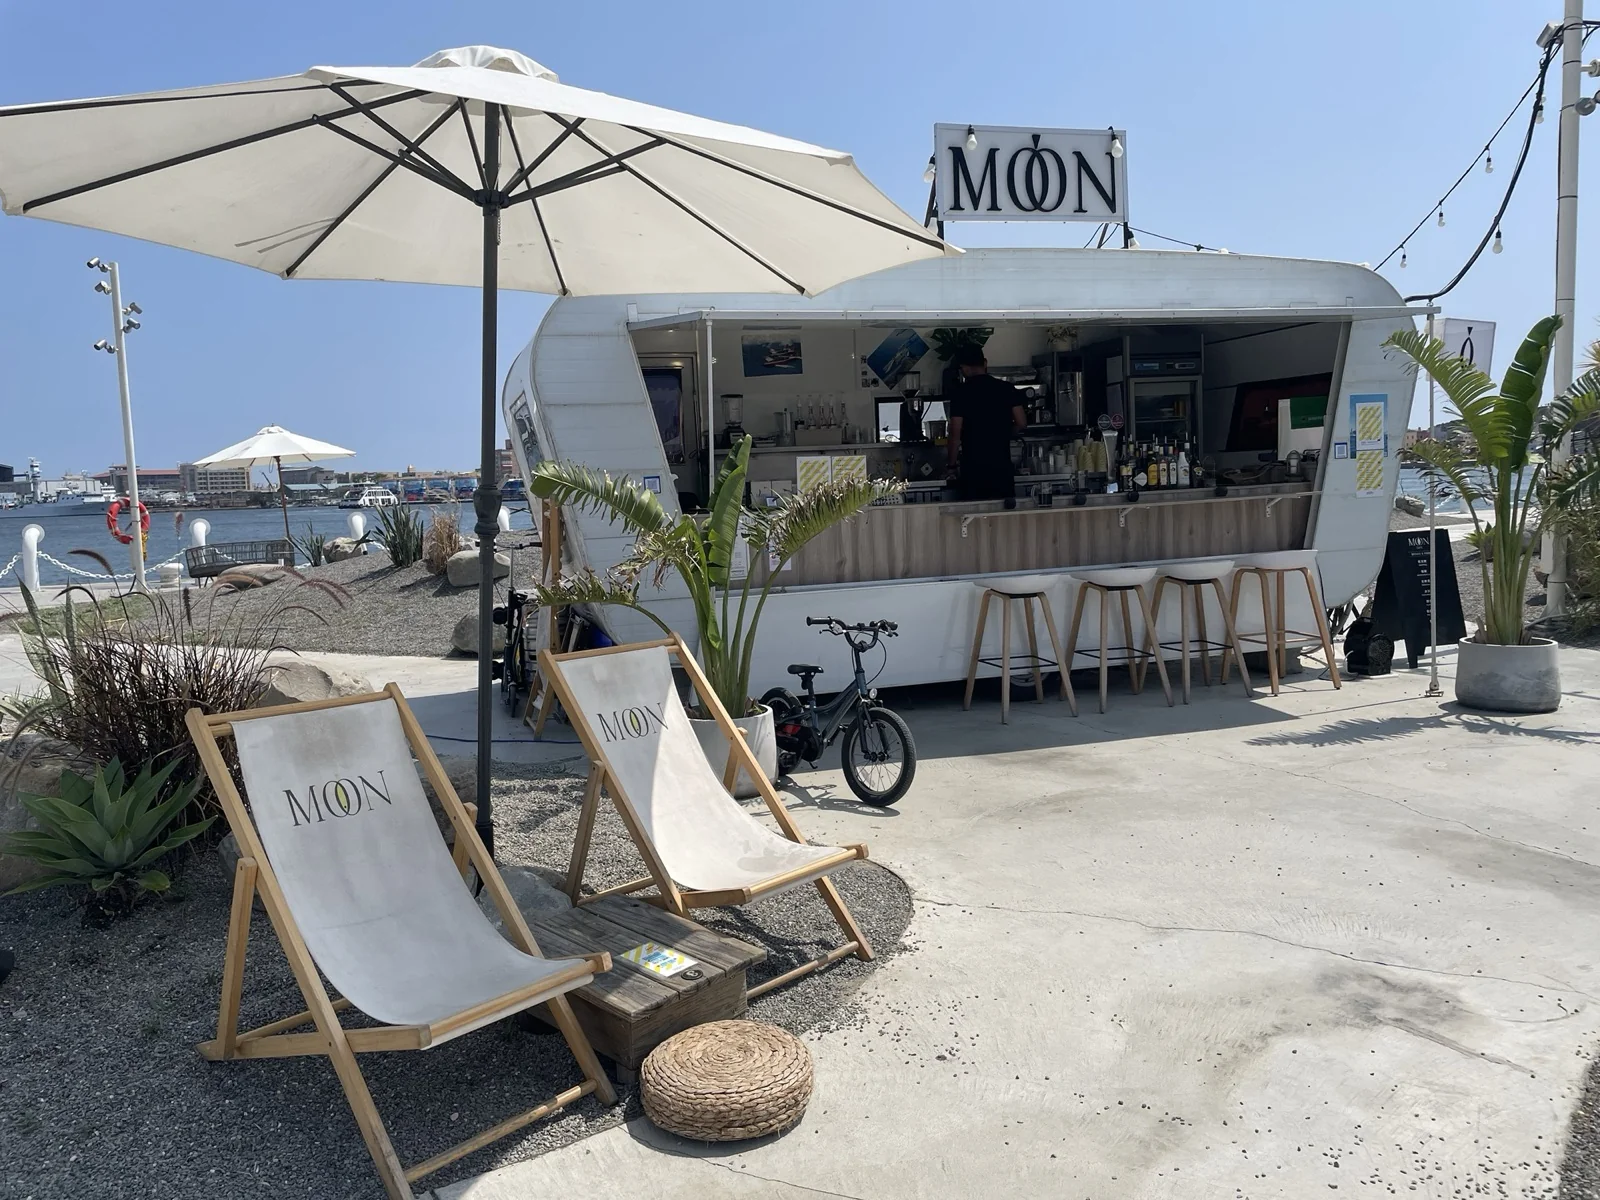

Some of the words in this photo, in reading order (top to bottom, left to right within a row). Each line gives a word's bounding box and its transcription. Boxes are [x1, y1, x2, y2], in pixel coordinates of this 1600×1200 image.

[948, 145, 1117, 214] MOON
[1408, 537, 1429, 546] MOON
[597, 702, 669, 743] MOON
[282, 769, 392, 827] MOON
